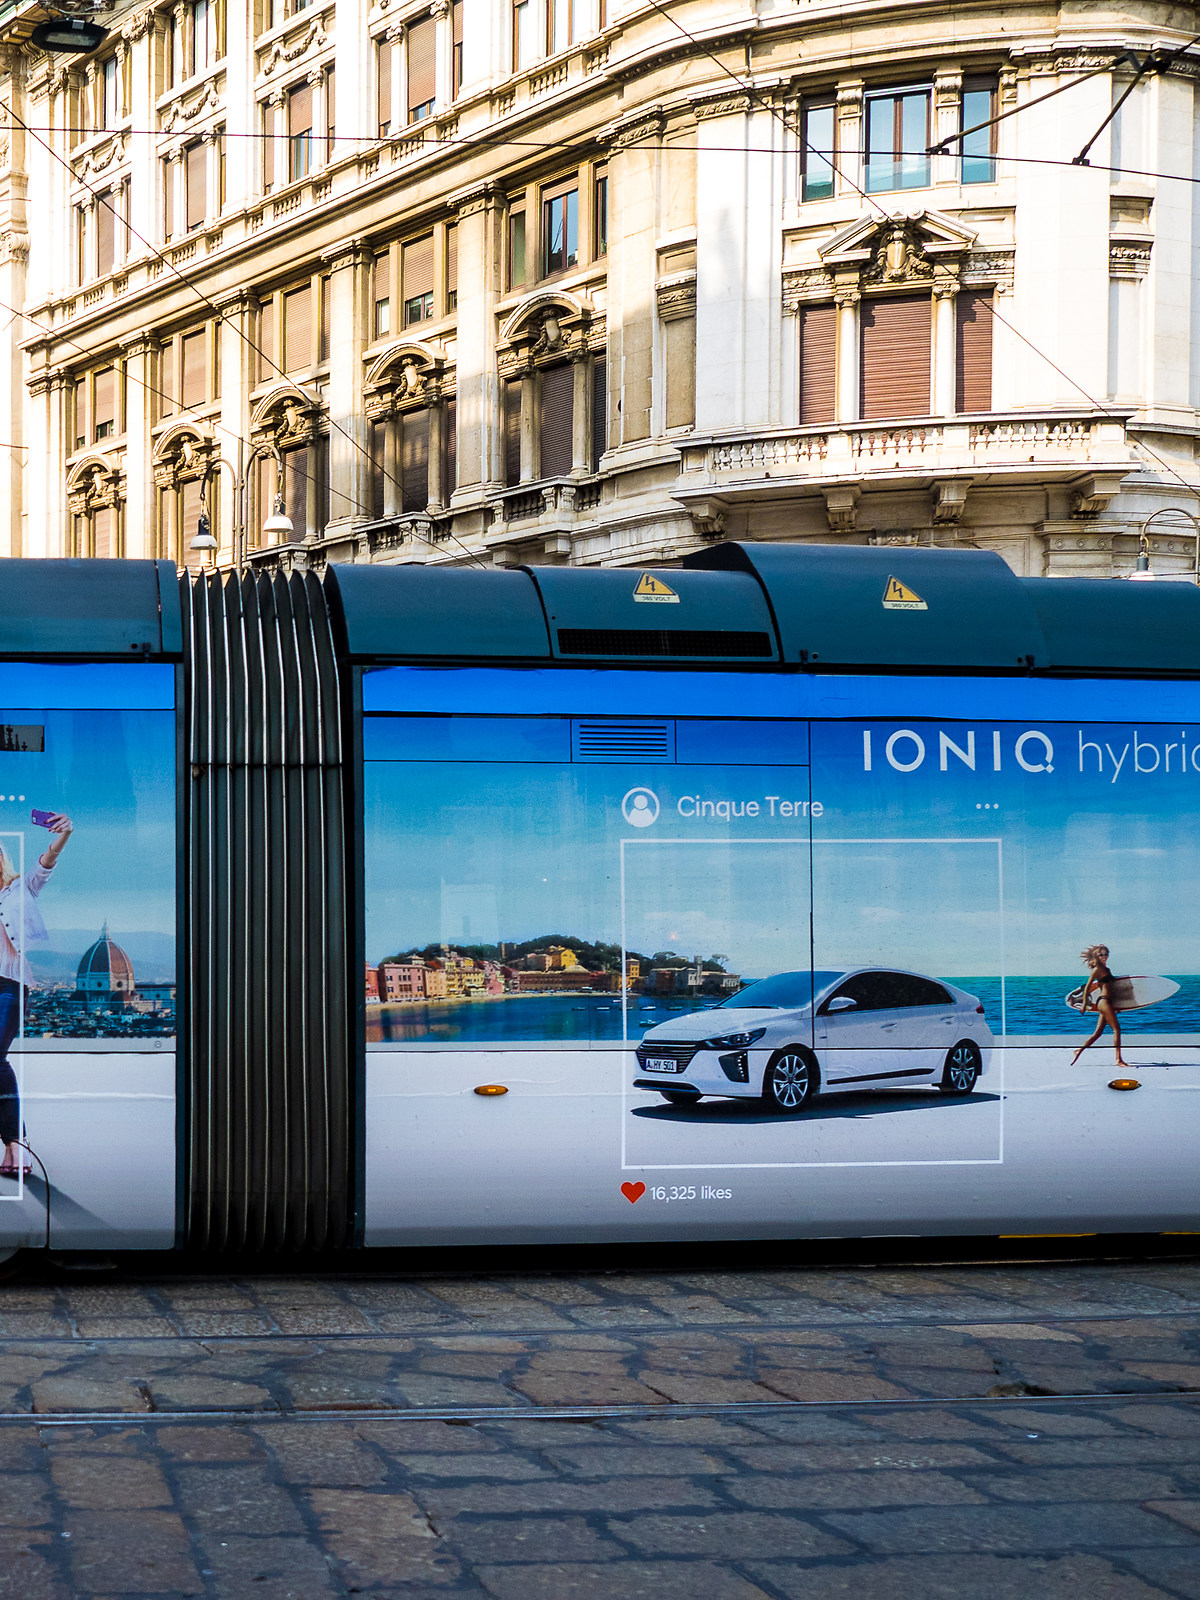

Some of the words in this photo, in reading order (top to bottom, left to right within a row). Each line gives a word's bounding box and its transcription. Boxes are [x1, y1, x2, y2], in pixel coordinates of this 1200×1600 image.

[863, 729, 1055, 774] IONIQ
[677, 795, 760, 822] Cinque
[765, 796, 824, 817] Terre
[650, 1186, 696, 1203] 16,325
[701, 1185, 733, 1199] likes
